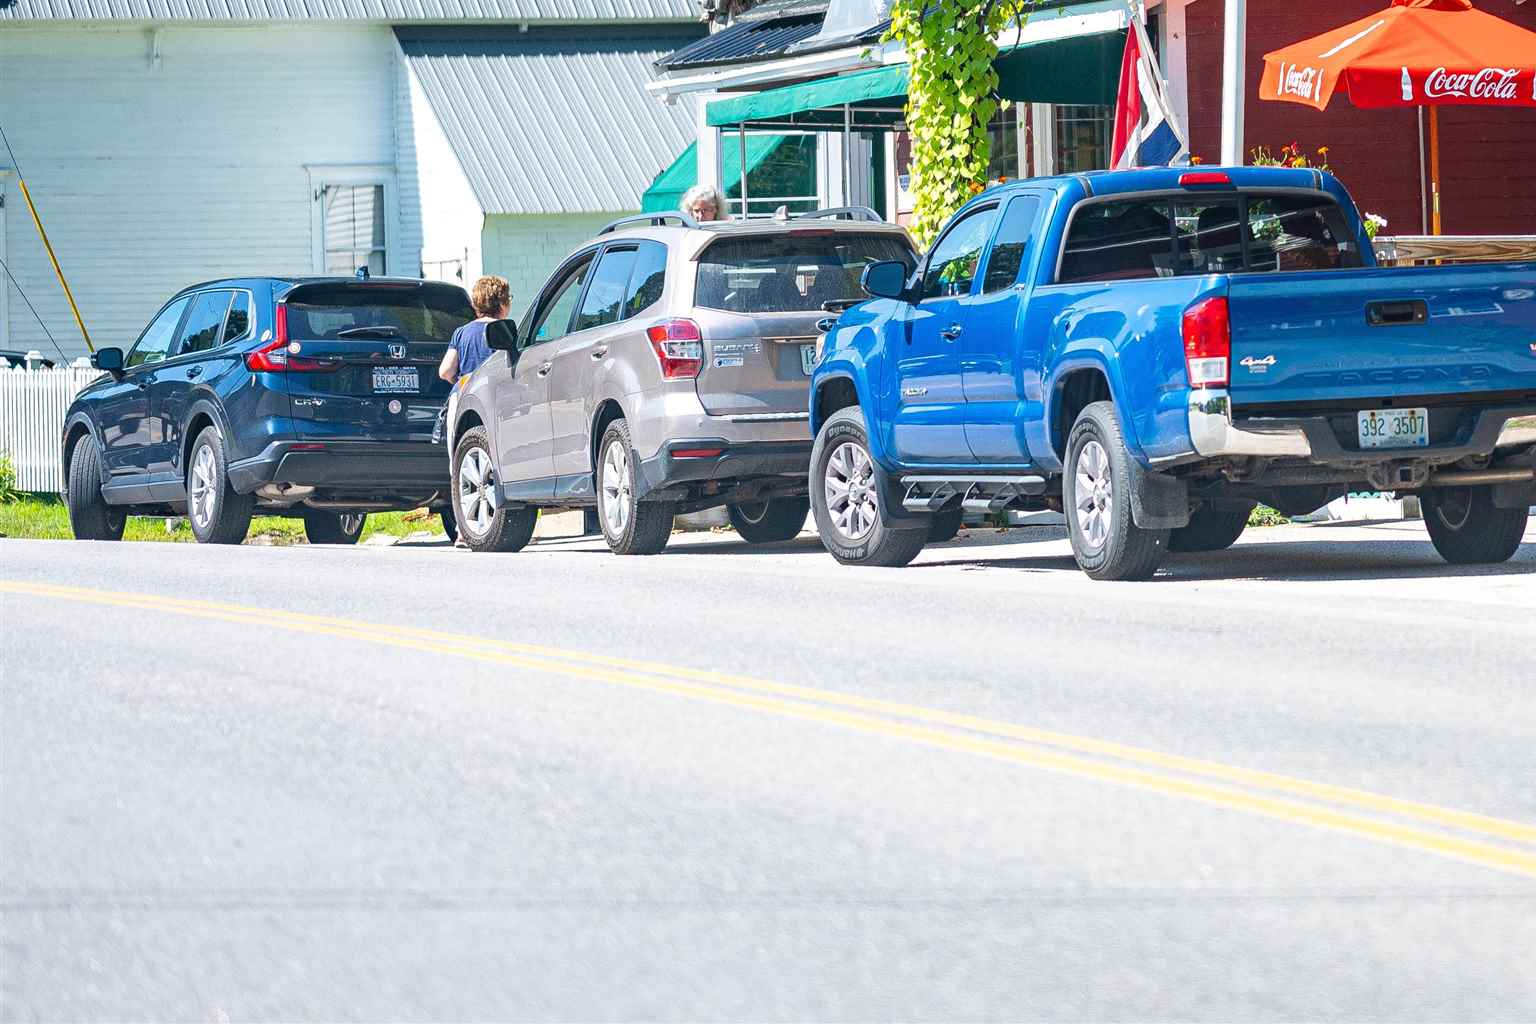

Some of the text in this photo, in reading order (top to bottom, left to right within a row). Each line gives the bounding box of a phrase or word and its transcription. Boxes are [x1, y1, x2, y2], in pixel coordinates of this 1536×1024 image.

[1424, 66, 1521, 99] Coca-Cola
[1361, 415, 1425, 437] 392 3507
